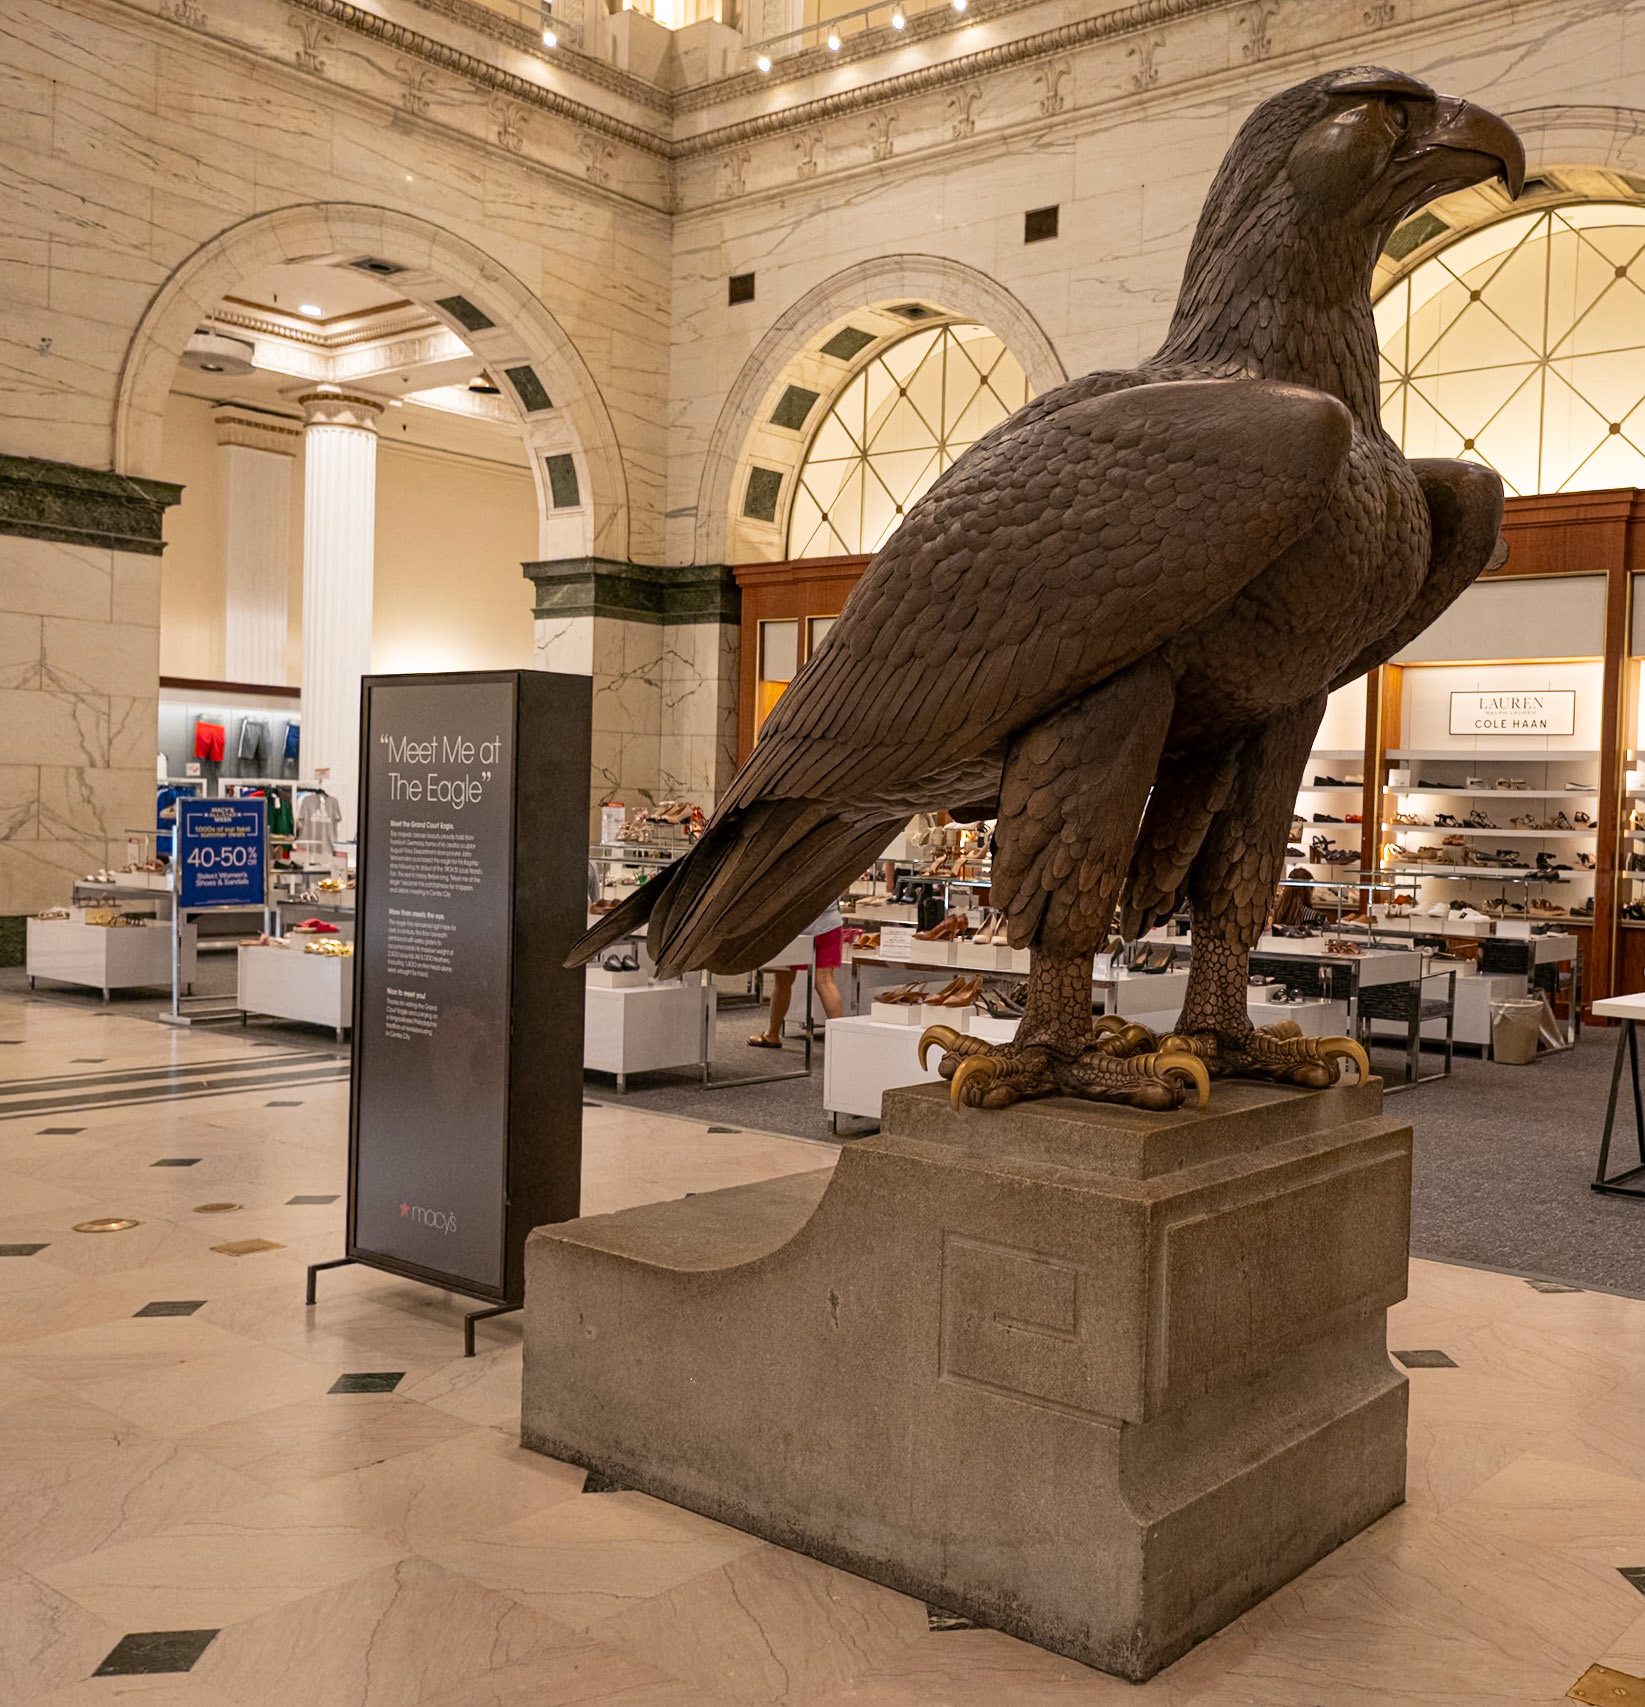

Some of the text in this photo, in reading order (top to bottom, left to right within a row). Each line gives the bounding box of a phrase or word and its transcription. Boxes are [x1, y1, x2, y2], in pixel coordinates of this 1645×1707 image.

[1479, 697, 1544, 710] LAUREN
[1474, 719, 1547, 729] COLE HAAN
[380, 733, 502, 764] “Meet Me at
[388, 771, 491, 810] The Eagle”
[411, 821, 426, 829] Grand
[426, 821, 440, 829] Court
[195, 878, 249, 887] Shoes & Sandals
[400, 908, 412, 916] than
[386, 987, 397, 995] Nice
[403, 990, 416, 998] meet
[412, 1206, 457, 1236] macy's
